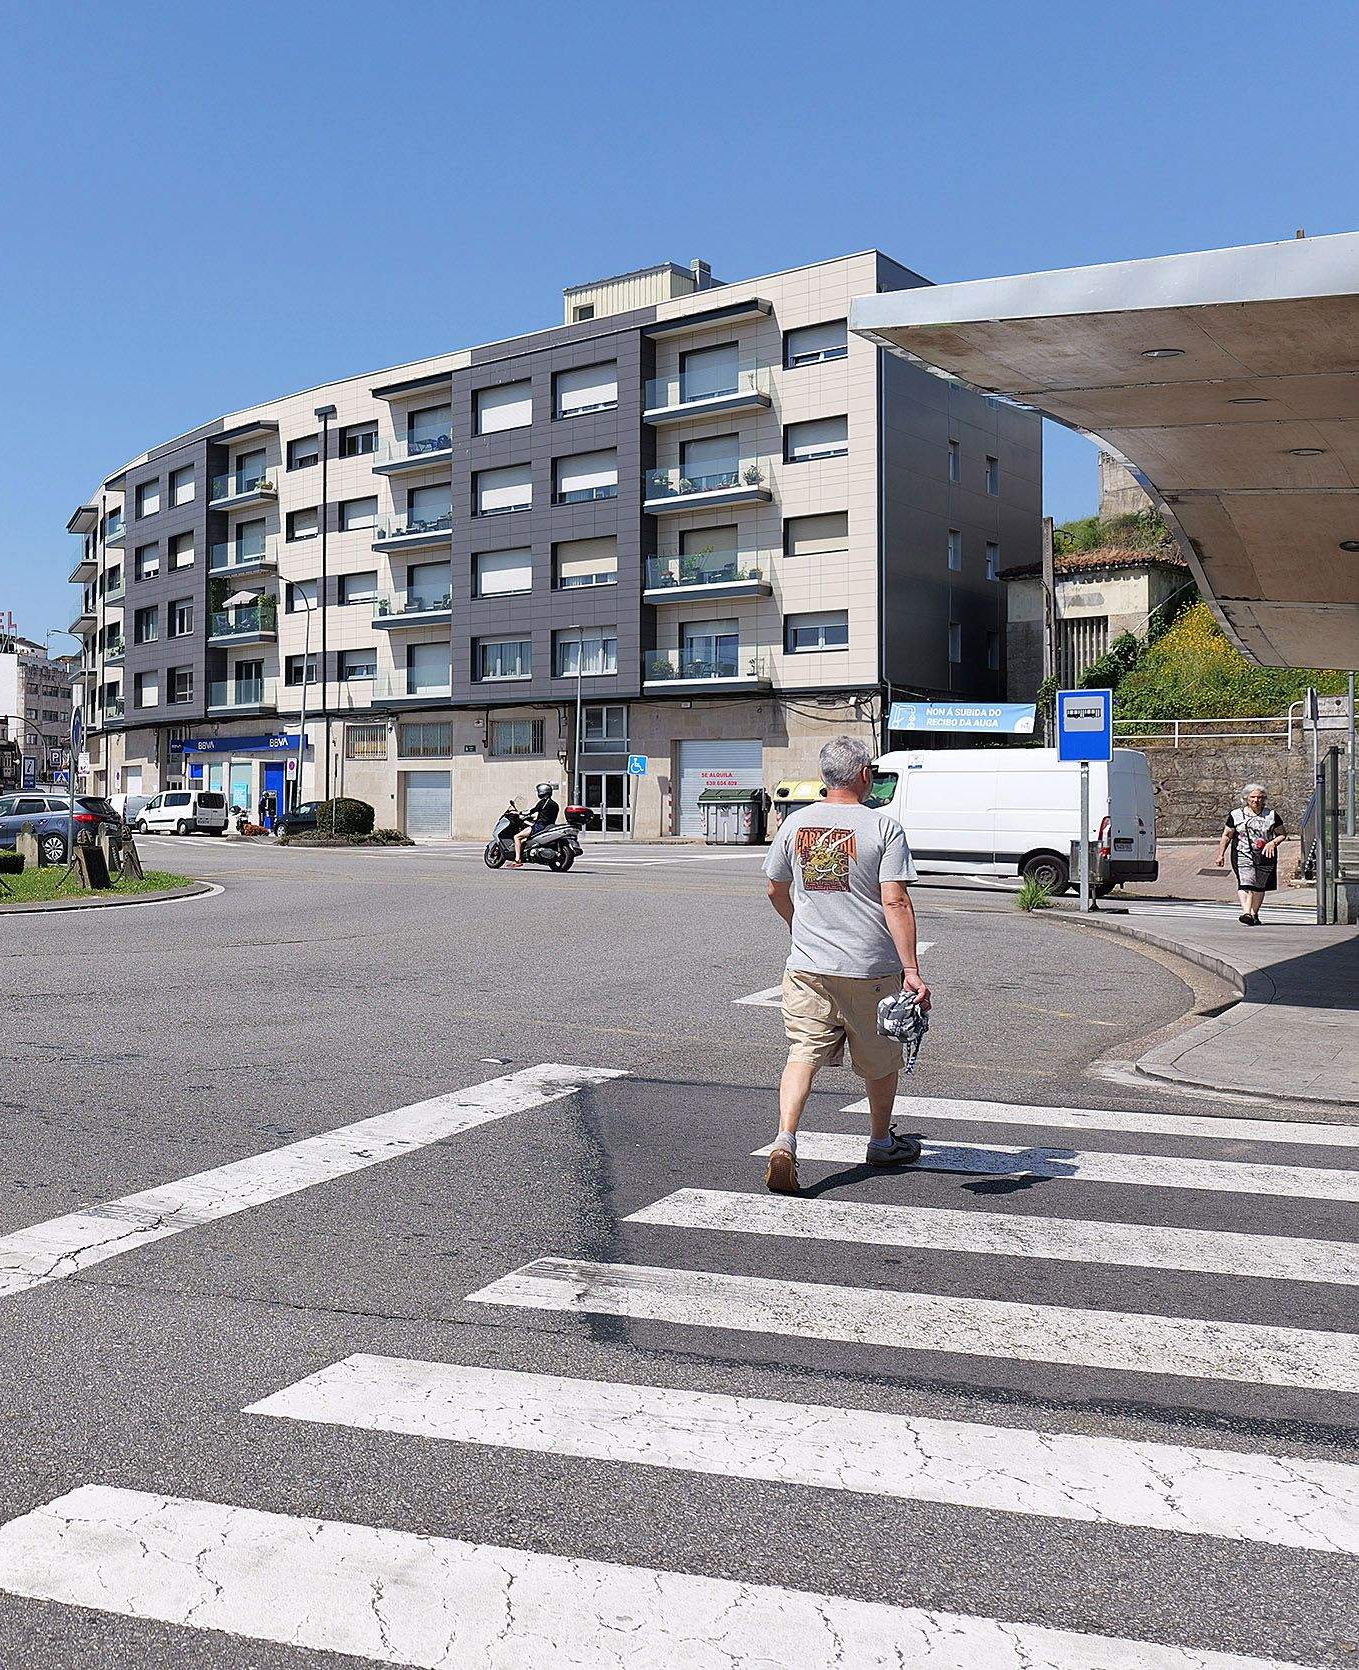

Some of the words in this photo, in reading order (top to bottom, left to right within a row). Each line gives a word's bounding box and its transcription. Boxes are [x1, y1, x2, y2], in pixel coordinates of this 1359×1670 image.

[926, 708, 945, 716] NON
[954, 708, 987, 717] SUBIDA
[988, 708, 1002, 717] DO
[926, 718, 958, 727] RECIBO
[959, 719, 972, 727] DA
[973, 719, 999, 728] AUGA
[197, 740, 215, 750] BBVA
[269, 737, 289, 748] BBVA
[52, 752, 59, 762] P
